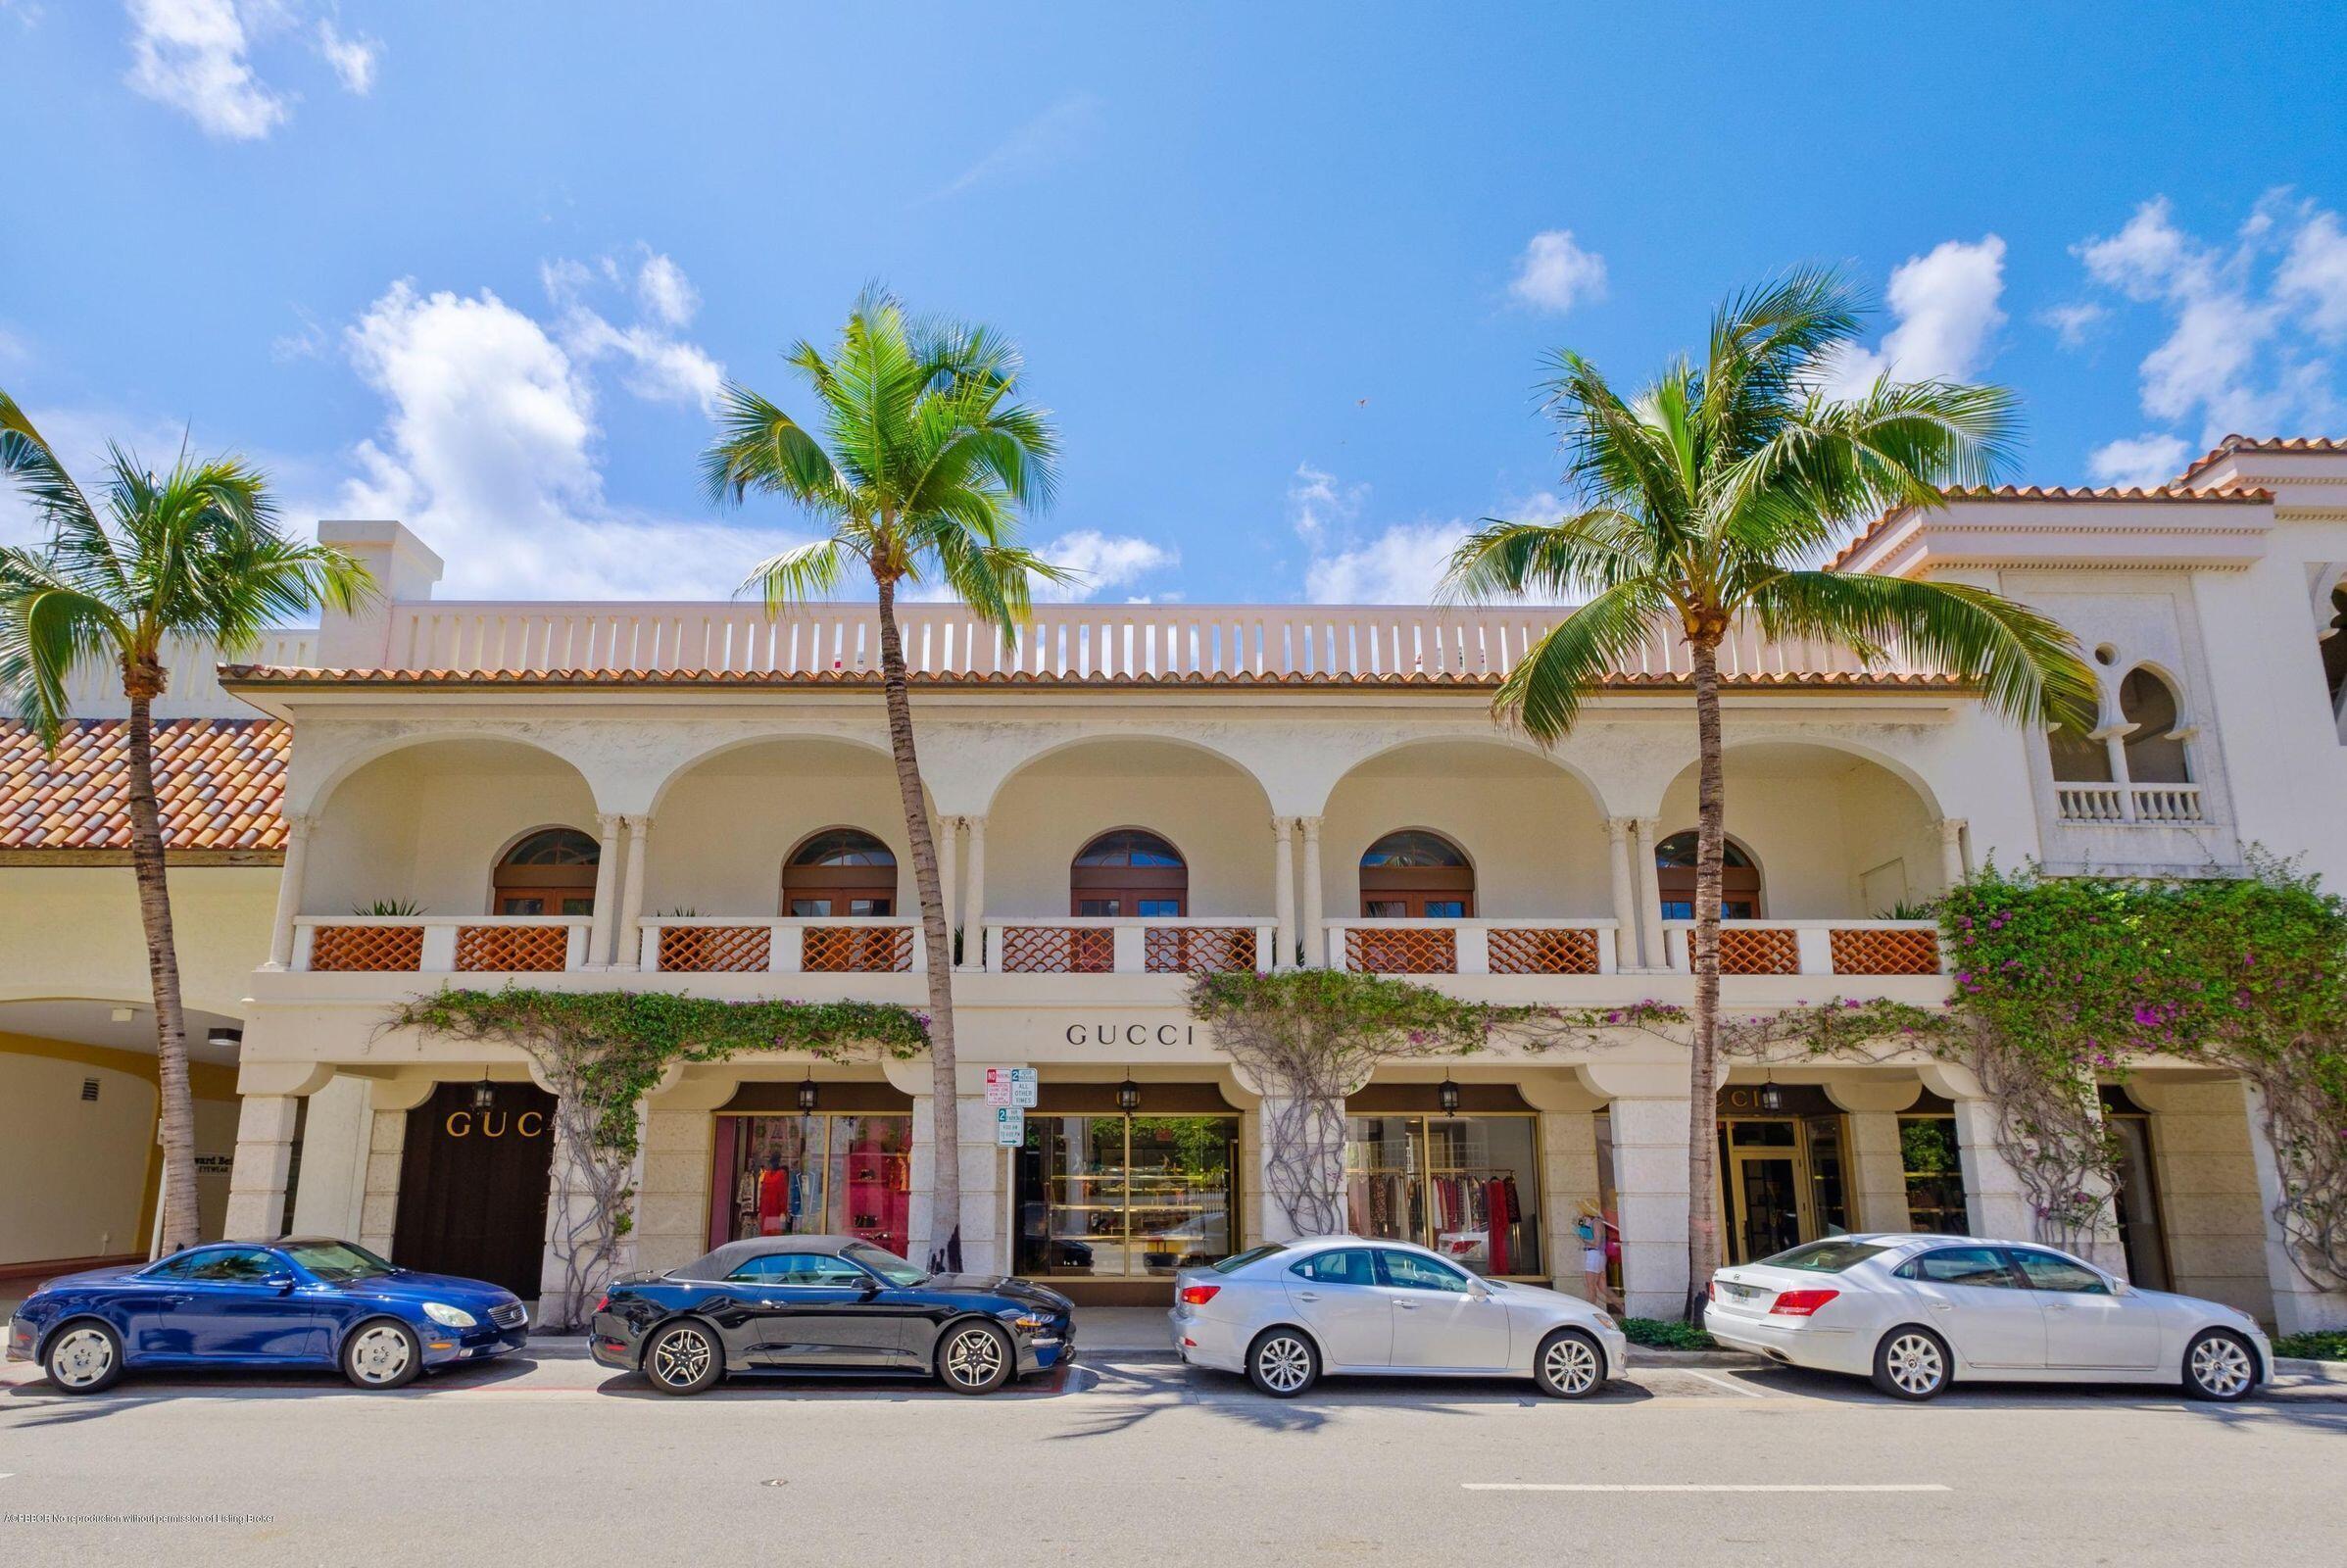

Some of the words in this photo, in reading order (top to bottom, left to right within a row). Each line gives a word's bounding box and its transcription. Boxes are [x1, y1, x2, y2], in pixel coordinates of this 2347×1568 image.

[1066, 1024, 1193, 1046] GUCCI
[988, 1071, 996, 1080] NO
[1012, 1070, 1018, 1081] 2
[1000, 1110, 1005, 1121] 2
